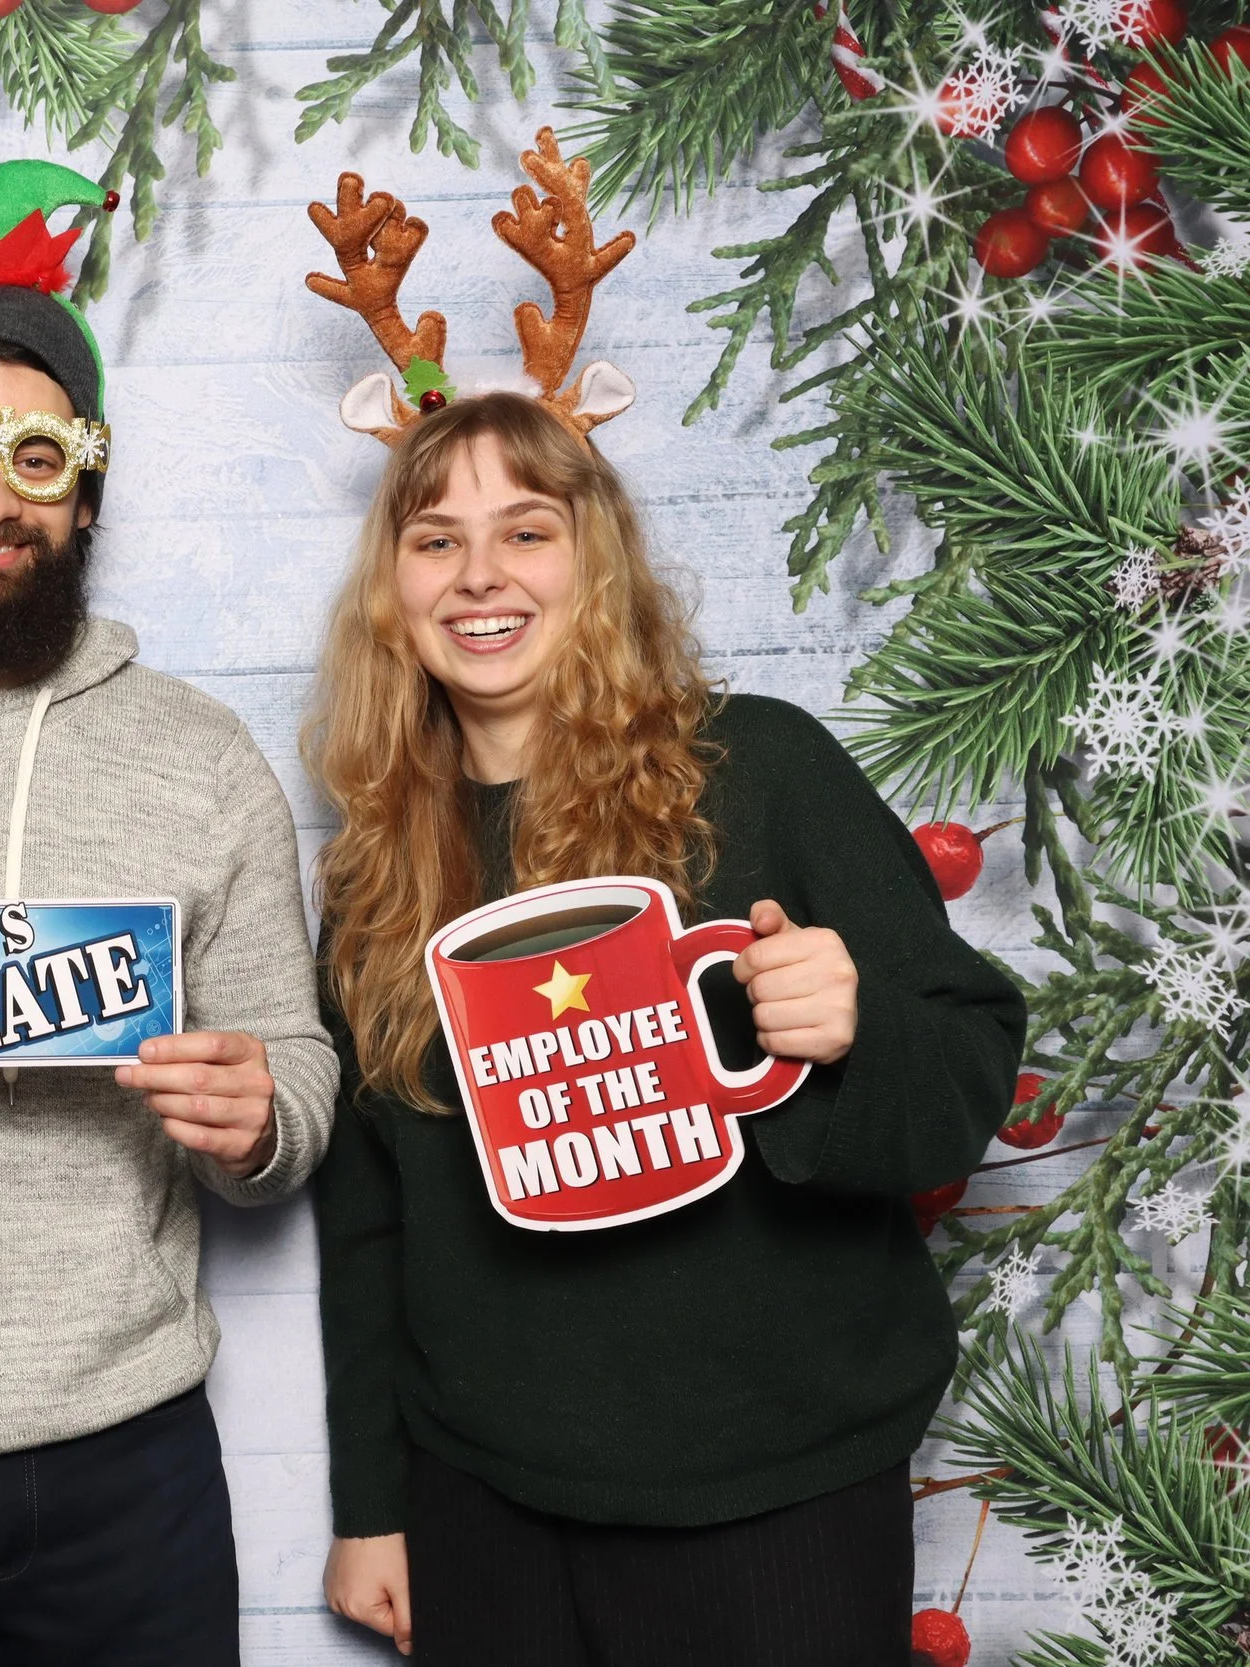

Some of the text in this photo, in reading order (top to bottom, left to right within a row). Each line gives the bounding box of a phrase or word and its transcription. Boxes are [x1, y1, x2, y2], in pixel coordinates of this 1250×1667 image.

[468, 1000, 689, 1087] EMPLOYEE
[518, 1061, 666, 1129] OF THE
[498, 1103, 722, 1201] MONTH
